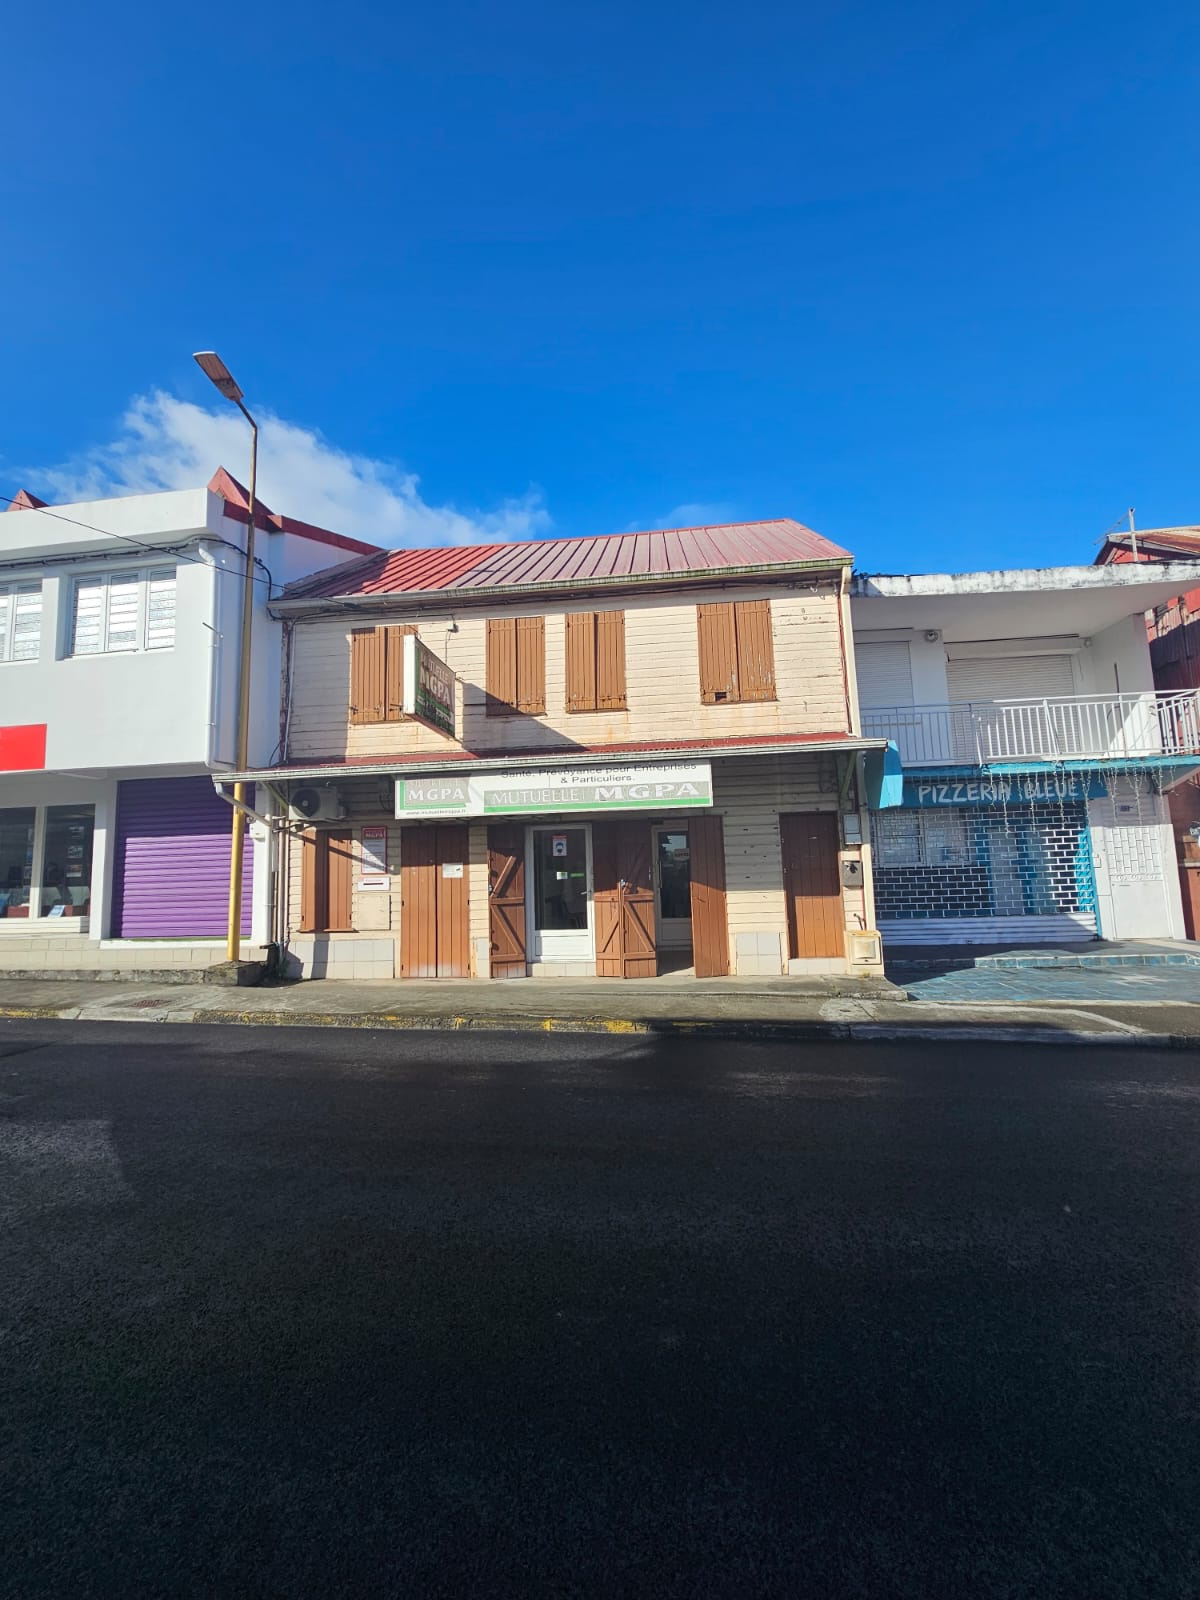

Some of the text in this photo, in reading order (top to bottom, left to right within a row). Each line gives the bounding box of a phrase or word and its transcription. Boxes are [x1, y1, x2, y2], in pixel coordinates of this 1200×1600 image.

[418, 668, 452, 705] MGPA
[605, 766, 631, 774] pour
[633, 763, 697, 773] Entreprises
[408, 788, 465, 801] MGPA
[491, 782, 699, 804] MUTUELLE MGPA
[918, 777, 1079, 803] PIZZERIA BLEUE
